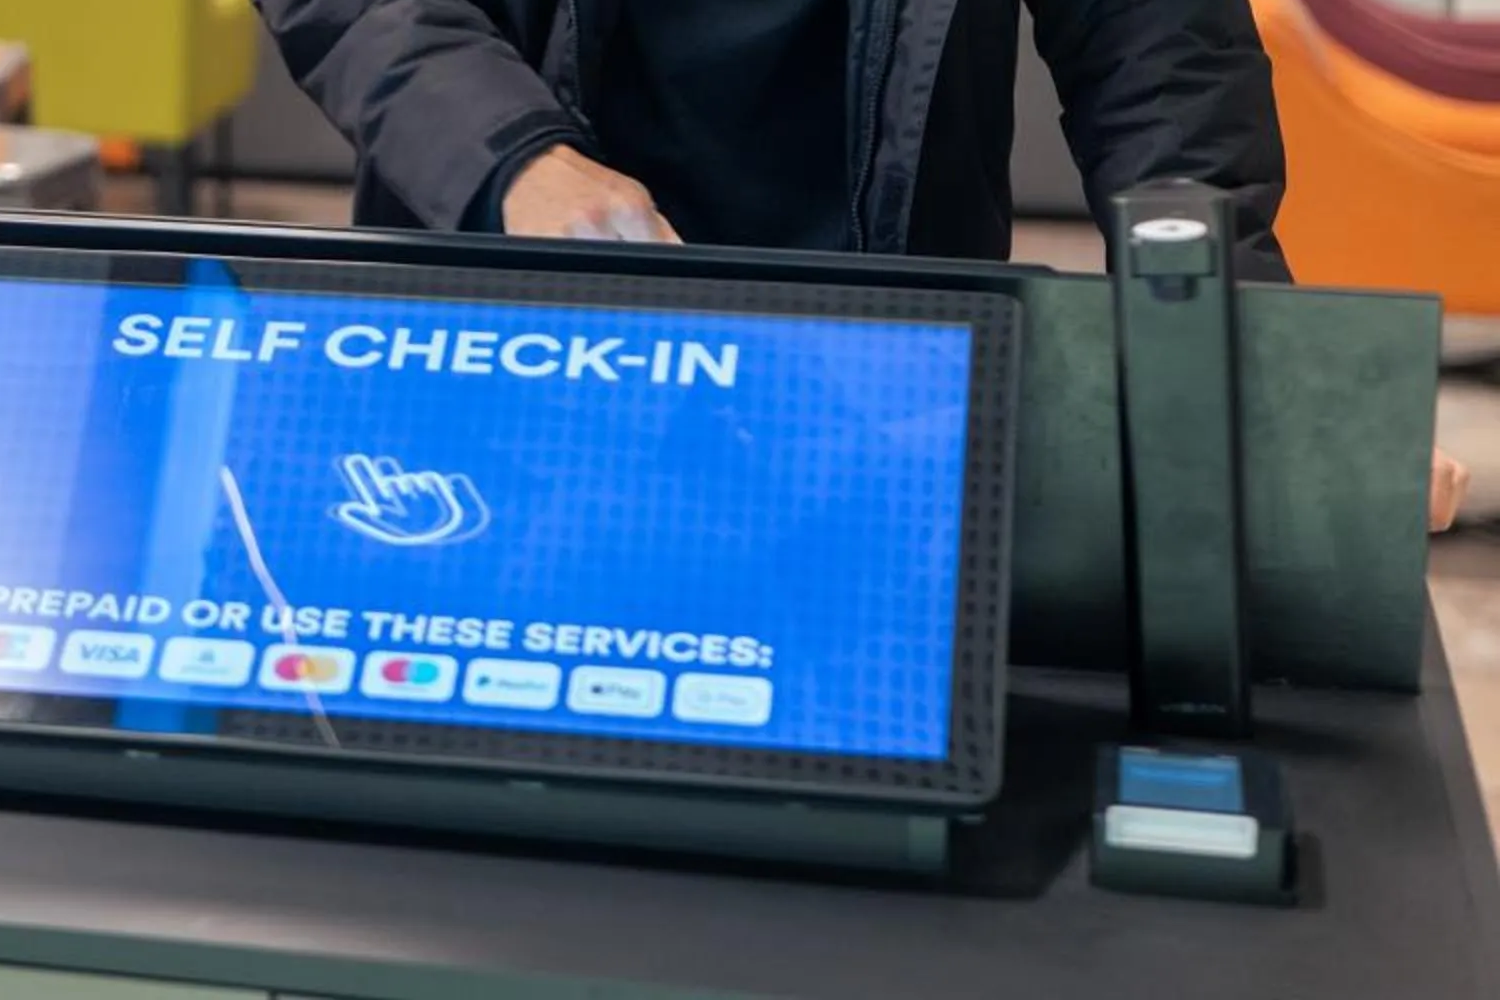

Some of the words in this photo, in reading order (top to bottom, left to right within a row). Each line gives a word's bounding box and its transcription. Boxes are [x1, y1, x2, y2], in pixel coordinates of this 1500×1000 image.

[113, 314, 306, 363] SELF
[324, 324, 738, 387] CHECK-IN
[81, 643, 140, 664] VISA
[182, 599, 251, 631] OR
[260, 604, 352, 638] USE
[362, 610, 515, 650] THESE
[522, 622, 774, 669] SERVICES:
